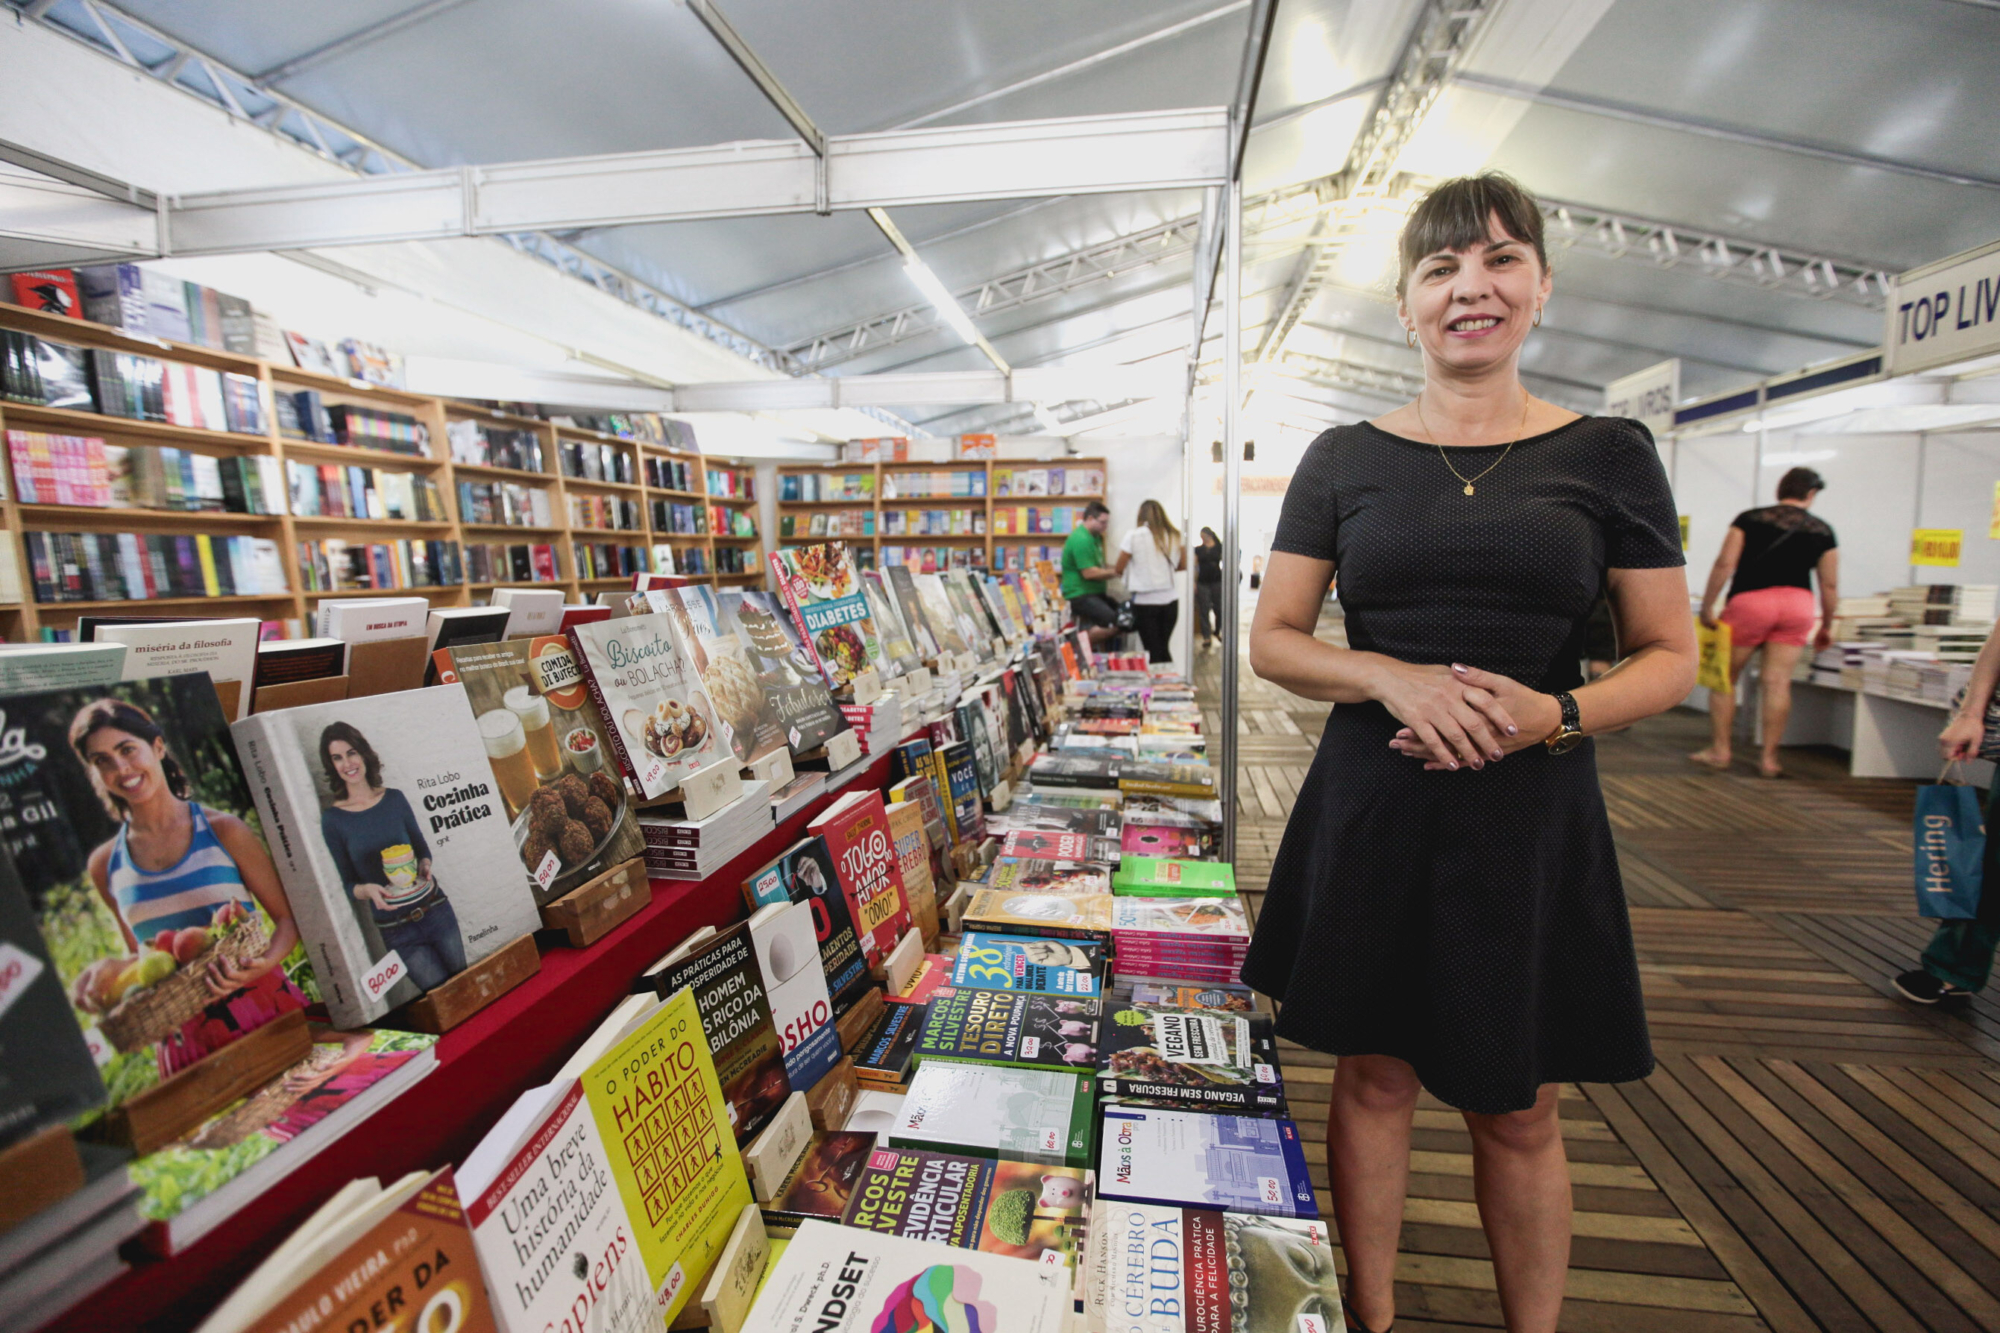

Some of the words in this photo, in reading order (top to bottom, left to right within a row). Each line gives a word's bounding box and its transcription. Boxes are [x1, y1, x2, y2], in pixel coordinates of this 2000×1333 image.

[1899, 290, 1950, 345] TOP
[805, 602, 867, 630] DIABETES
[135, 643, 176, 653] miséria
[179, 642, 191, 650] da
[194, 638, 232, 649] filosofia
[606, 633, 672, 669] Biscoito
[541, 654, 573, 673] COMIDA
[554, 664, 581, 683] BUTECO
[614, 678, 627, 687] ou
[627, 658, 686, 687] BOLACHA?
[612, 734, 633, 772] BISCOITO
[417, 777, 437, 790] Rita
[437, 771, 461, 785] Lobo
[952, 764, 973, 784] VOCÊ
[248, 740, 259, 760] Rita
[255, 760, 266, 784] Lobo
[264, 786, 281, 824] Cozinha
[276, 824, 293, 859] Prática
[422, 782, 490, 812] Cozinha
[429, 803, 492, 834] Prática
[436, 835, 450, 847] gnt
[843, 830, 886, 881] JOGO
[894, 829, 920, 858] SUPER
[1058, 835, 1075, 858] PODER
[1919, 815, 1952, 892] Hering
[855, 861, 890, 908] AMOR
[468, 924, 499, 943] Panelinha
[671, 974, 683, 988] AS
[683, 950, 721, 980] PRÁTICAS
[722, 937, 742, 957] PARA
[738, 947, 749, 961] DE
[959, 944, 1013, 988] 38
[1014, 954, 1025, 976] VENCER
[368, 963, 399, 994] 80,00
[833, 958, 863, 992] SILVESTRE
[956, 963, 966, 984] ARTHUR
[1015, 976, 1024, 989] PARA
[1025, 964, 1034, 989] QUALQUER
[1036, 966, 1046, 990] DEBATE
[698, 971, 746, 1014] HOMEM
[712, 997, 742, 1028] RICO
[743, 984, 763, 1009] DA
[922, 999, 951, 1050] MARCOS
[939, 990, 972, 1051] SILVESTRE
[958, 991, 993, 1053] TESOURO
[979, 993, 1014, 1055] DIRETO
[1011, 994, 1026, 1026] POUPANÇA
[796, 1027, 831, 1062] perigosamente
[867, 1036, 891, 1065] MARCOS
[885, 1005, 910, 1036] SILVESTRE
[1005, 1027, 1018, 1048] NOVA
[1163, 1016, 1185, 1058] VEGANO
[1188, 1018, 1202, 1046] FRESCURA
[606, 1080, 617, 1094] O
[622, 1038, 665, 1081] PODER
[670, 1019, 687, 1040] DO
[731, 1044, 768, 1077] McCREADIE
[1193, 1045, 1203, 1059] SEM
[612, 1041, 695, 1133] HÁBITO
[1129, 1083, 1179, 1097] FRESCURA
[1180, 1086, 1202, 1098] SEM
[1204, 1090, 1245, 1103] VEGANO
[1118, 1121, 1132, 1145] Obra
[501, 1178, 549, 1235] Uma
[546, 1122, 587, 1181] breve
[1116, 1155, 1131, 1184] Mãos
[682, 1181, 702, 1203] fazemos
[954, 1164, 980, 1235] APOSENTADORIA
[976, 1197, 986, 1222] depender
[983, 1167, 992, 1188] governos
[1267, 1179, 1278, 1202] 50,00
[513, 1179, 577, 1268] história
[578, 1151, 595, 1182] da
[515, 1169, 608, 1311] humanidade
[675, 1213, 698, 1242] CHARLES
[1192, 1216, 1202, 1259] PRÁTICA
[1097, 1231, 1108, 1274] HANSON
[1120, 1212, 1145, 1317] CÉREBRO
[1150, 1217, 1180, 1318] BUDA
[1206, 1228, 1218, 1288] FELICIDADE
[333, 1250, 389, 1301] VIEIRA
[413, 1247, 451, 1291] DA
[541, 1225, 627, 1333] apiens
[863, 1256, 881, 1288] sucesso
[1095, 1279, 1106, 1306] RICK
[1210, 1304, 1220, 1333] PARA
